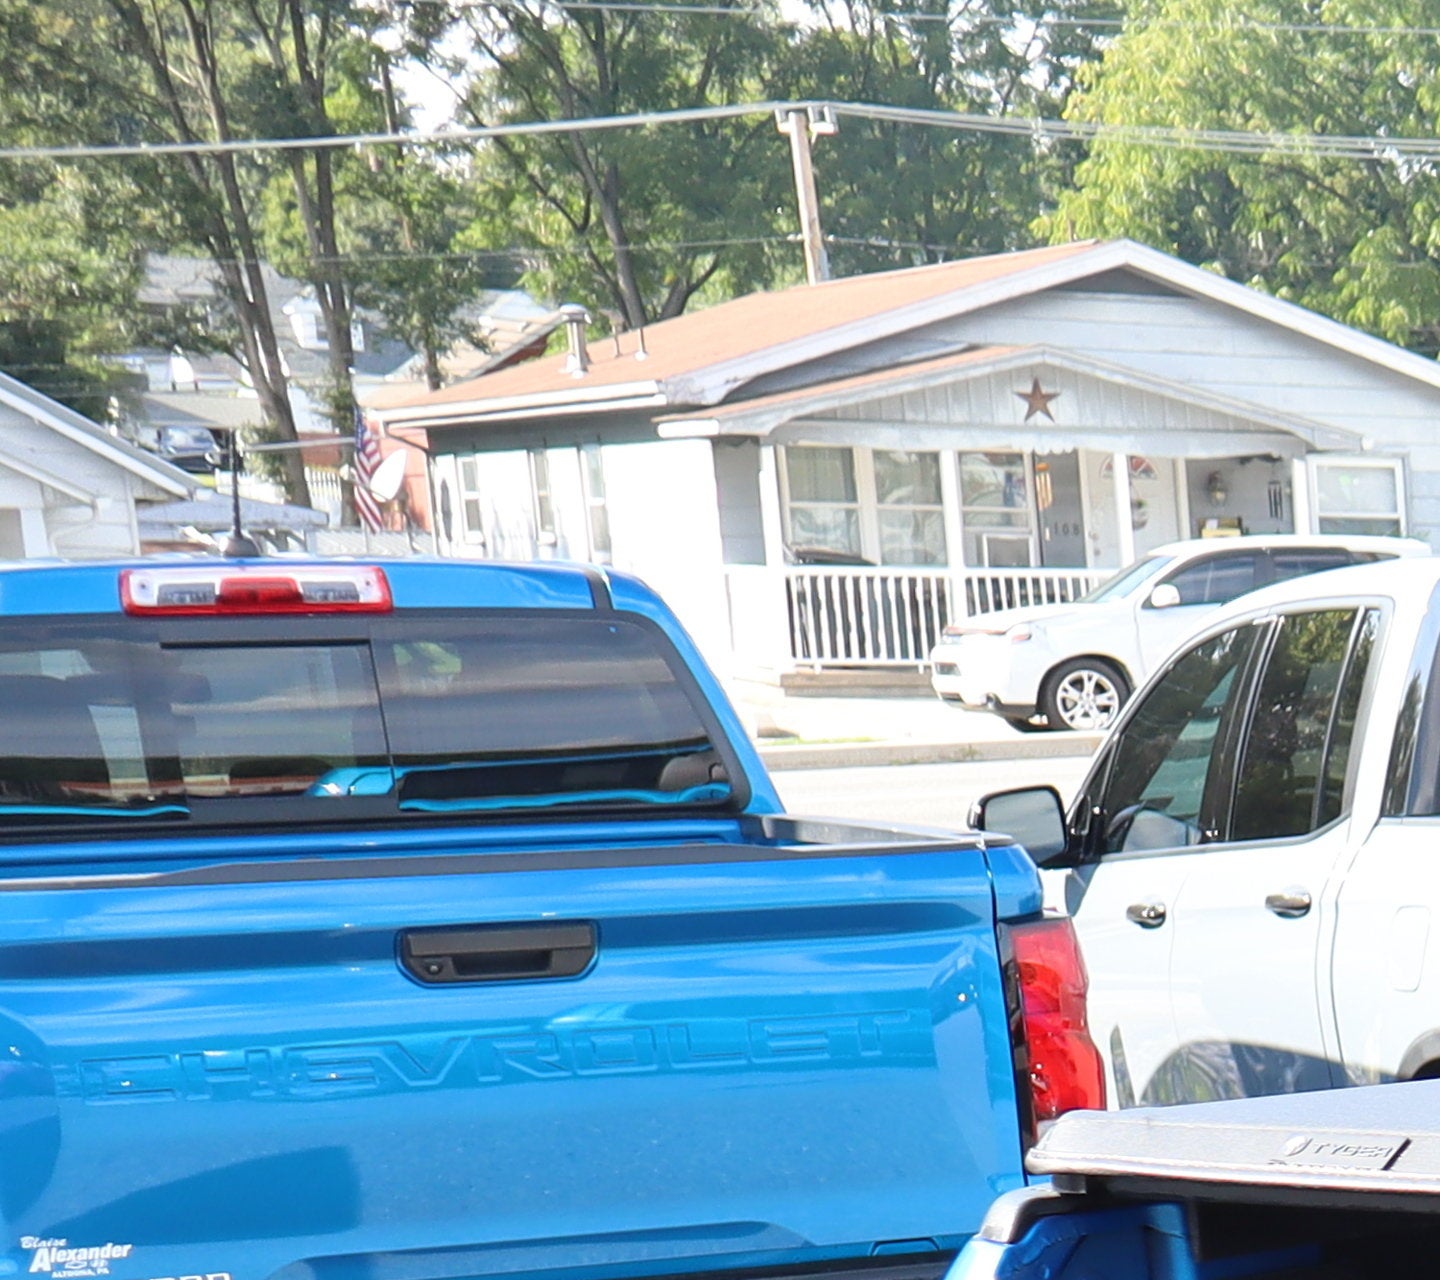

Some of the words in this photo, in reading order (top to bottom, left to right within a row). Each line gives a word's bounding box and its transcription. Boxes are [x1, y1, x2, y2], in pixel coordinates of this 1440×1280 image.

[80, 1009, 912, 1106] CHEVROLET
[1314, 1143, 1395, 1158] TYGER
[28, 1242, 133, 1273] Alexander
